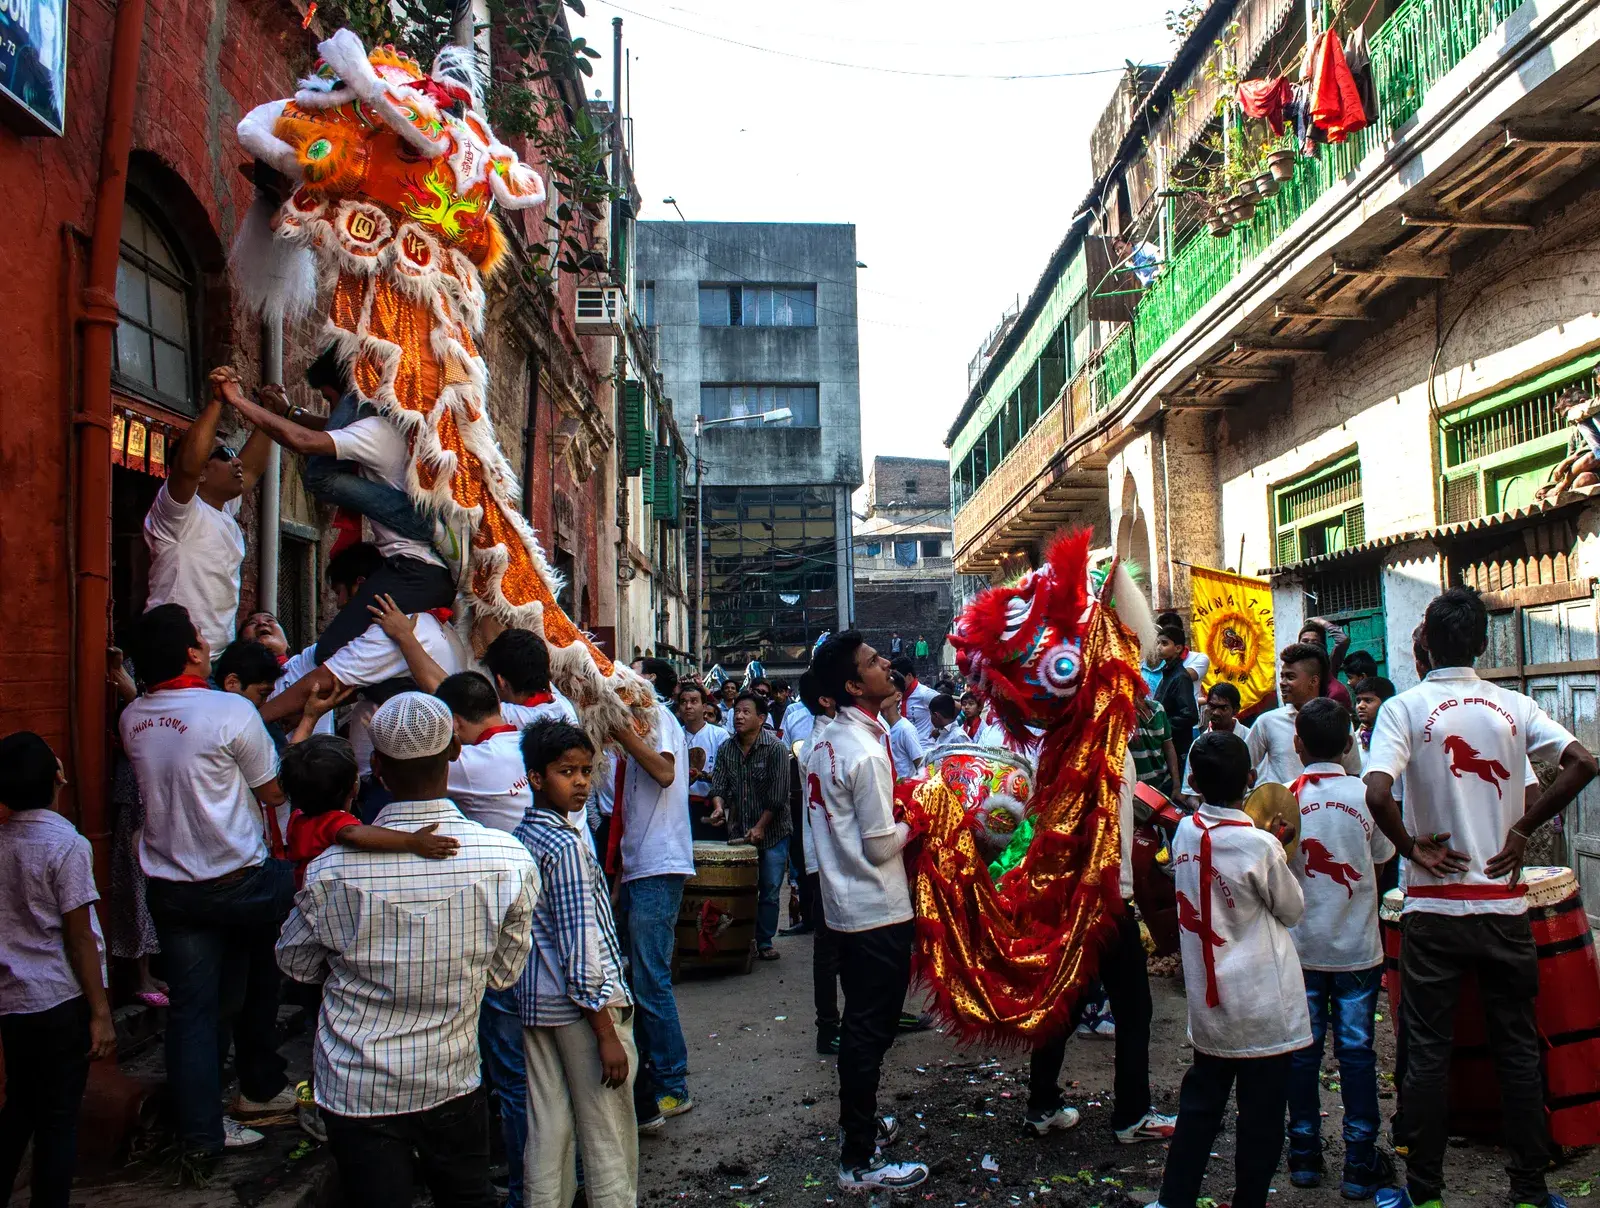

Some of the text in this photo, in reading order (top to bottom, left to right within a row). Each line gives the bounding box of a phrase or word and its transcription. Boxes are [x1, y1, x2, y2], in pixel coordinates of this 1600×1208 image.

[129, 717, 188, 740] CHINA TOWN
[1423, 697, 1518, 743] UNITED FRIENDS
[1325, 801, 1371, 842] FRIENDS
[1192, 854, 1236, 909] FENDS
